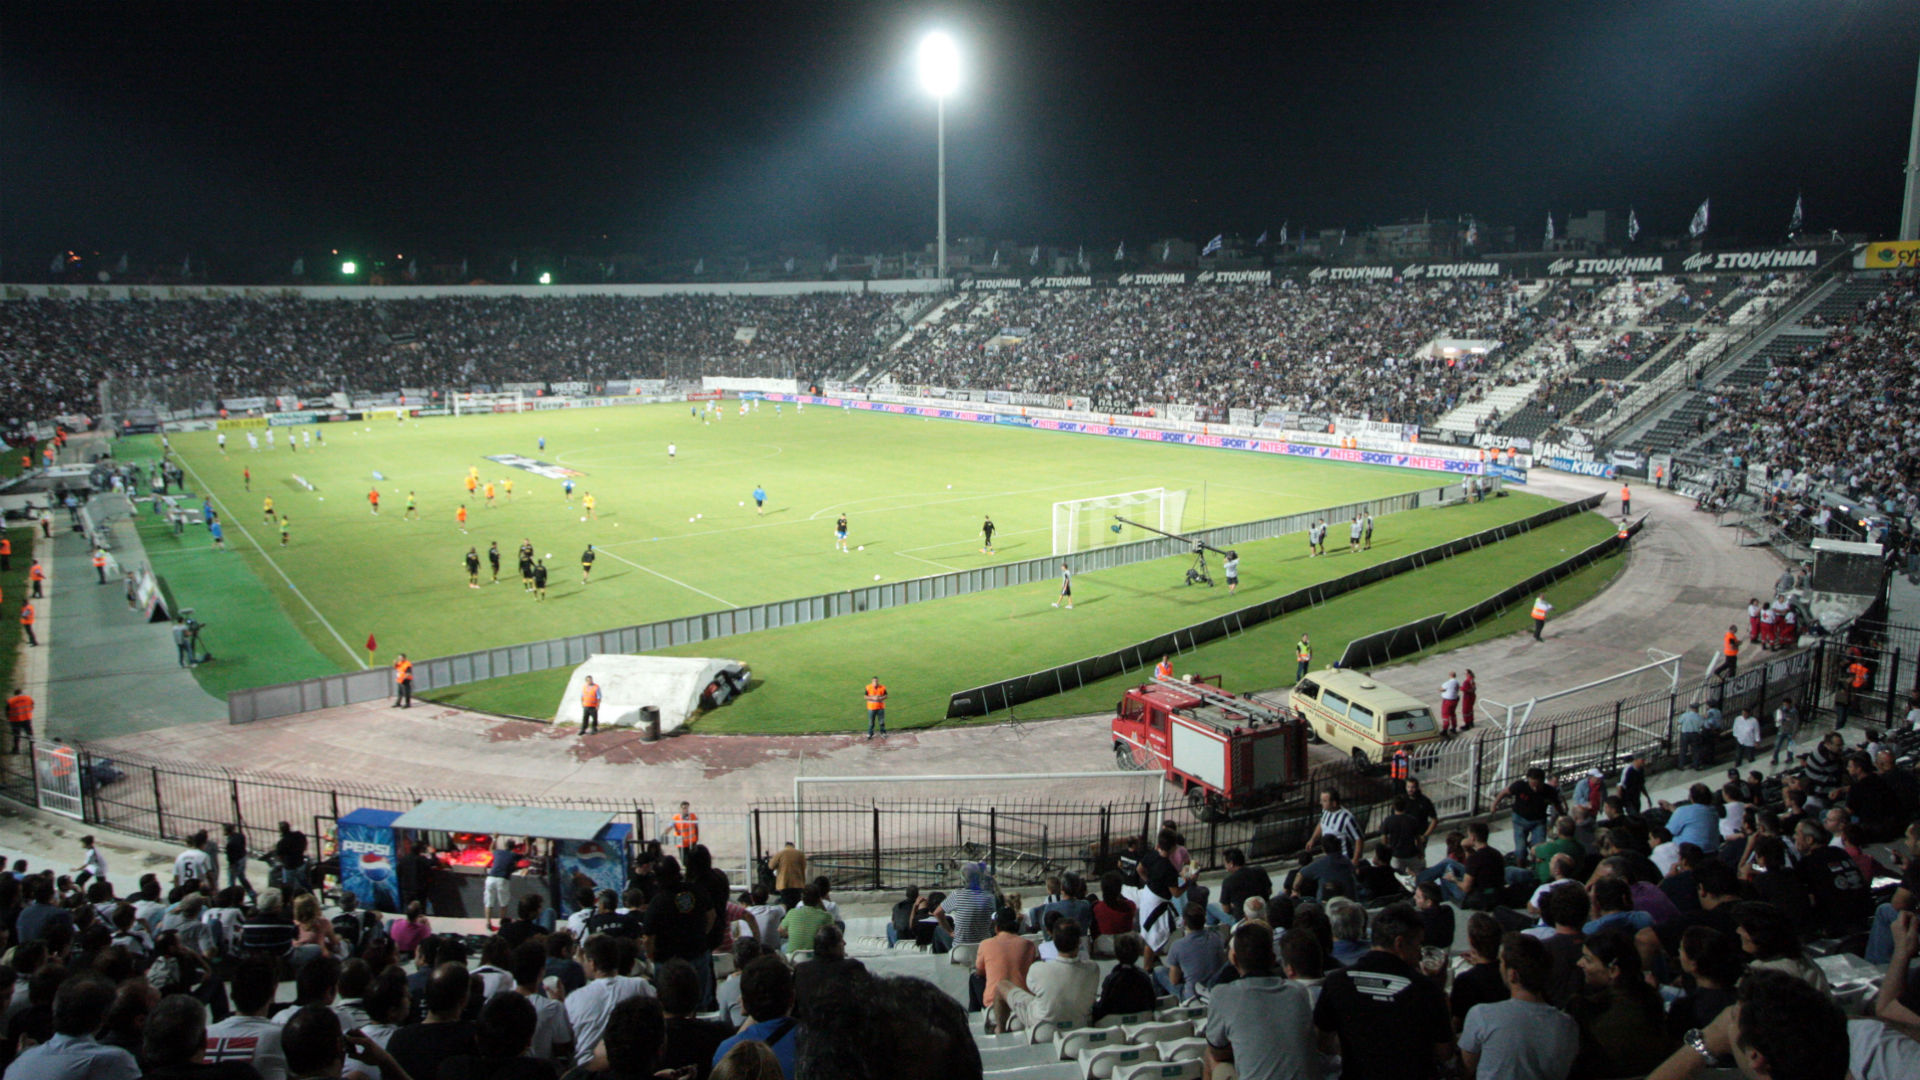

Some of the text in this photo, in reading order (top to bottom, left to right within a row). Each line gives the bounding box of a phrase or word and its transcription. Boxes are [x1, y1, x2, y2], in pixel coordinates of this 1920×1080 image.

[1575, 255, 1663, 274] ΣΤΟΙΧΗΜΑ
[1714, 249, 1818, 270] ΣΤΟΙΧΗΜΑ
[1216, 269, 1272, 283] ΣΤΟΙΧΗΜΑ
[1329, 265, 1394, 280] ΣΤΟΙΧΗΜΑ
[1426, 261, 1500, 278] ΣΤΟΙΧΗΜΑ
[1045, 275, 1092, 287] ΣΤΟΙΧΗΜΑ
[1134, 272, 1185, 286] ΣΤΟΙΧΗΜΑ
[1038, 418, 1077, 431] INTERSPORT
[1086, 424, 1128, 437] INTERSPORT
[1138, 429, 1185, 443] INTERSPORT
[1195, 435, 1247, 449] INTERSPORT
[1260, 441, 1316, 457] INTERSPORT
[1330, 449, 1394, 465] INTERSPORT
[1409, 456, 1480, 474] INTERSPORT
[1571, 460, 1604, 476] KIKU
[342, 840, 390, 856] PEPSI
[184, 861, 194, 878] 5
